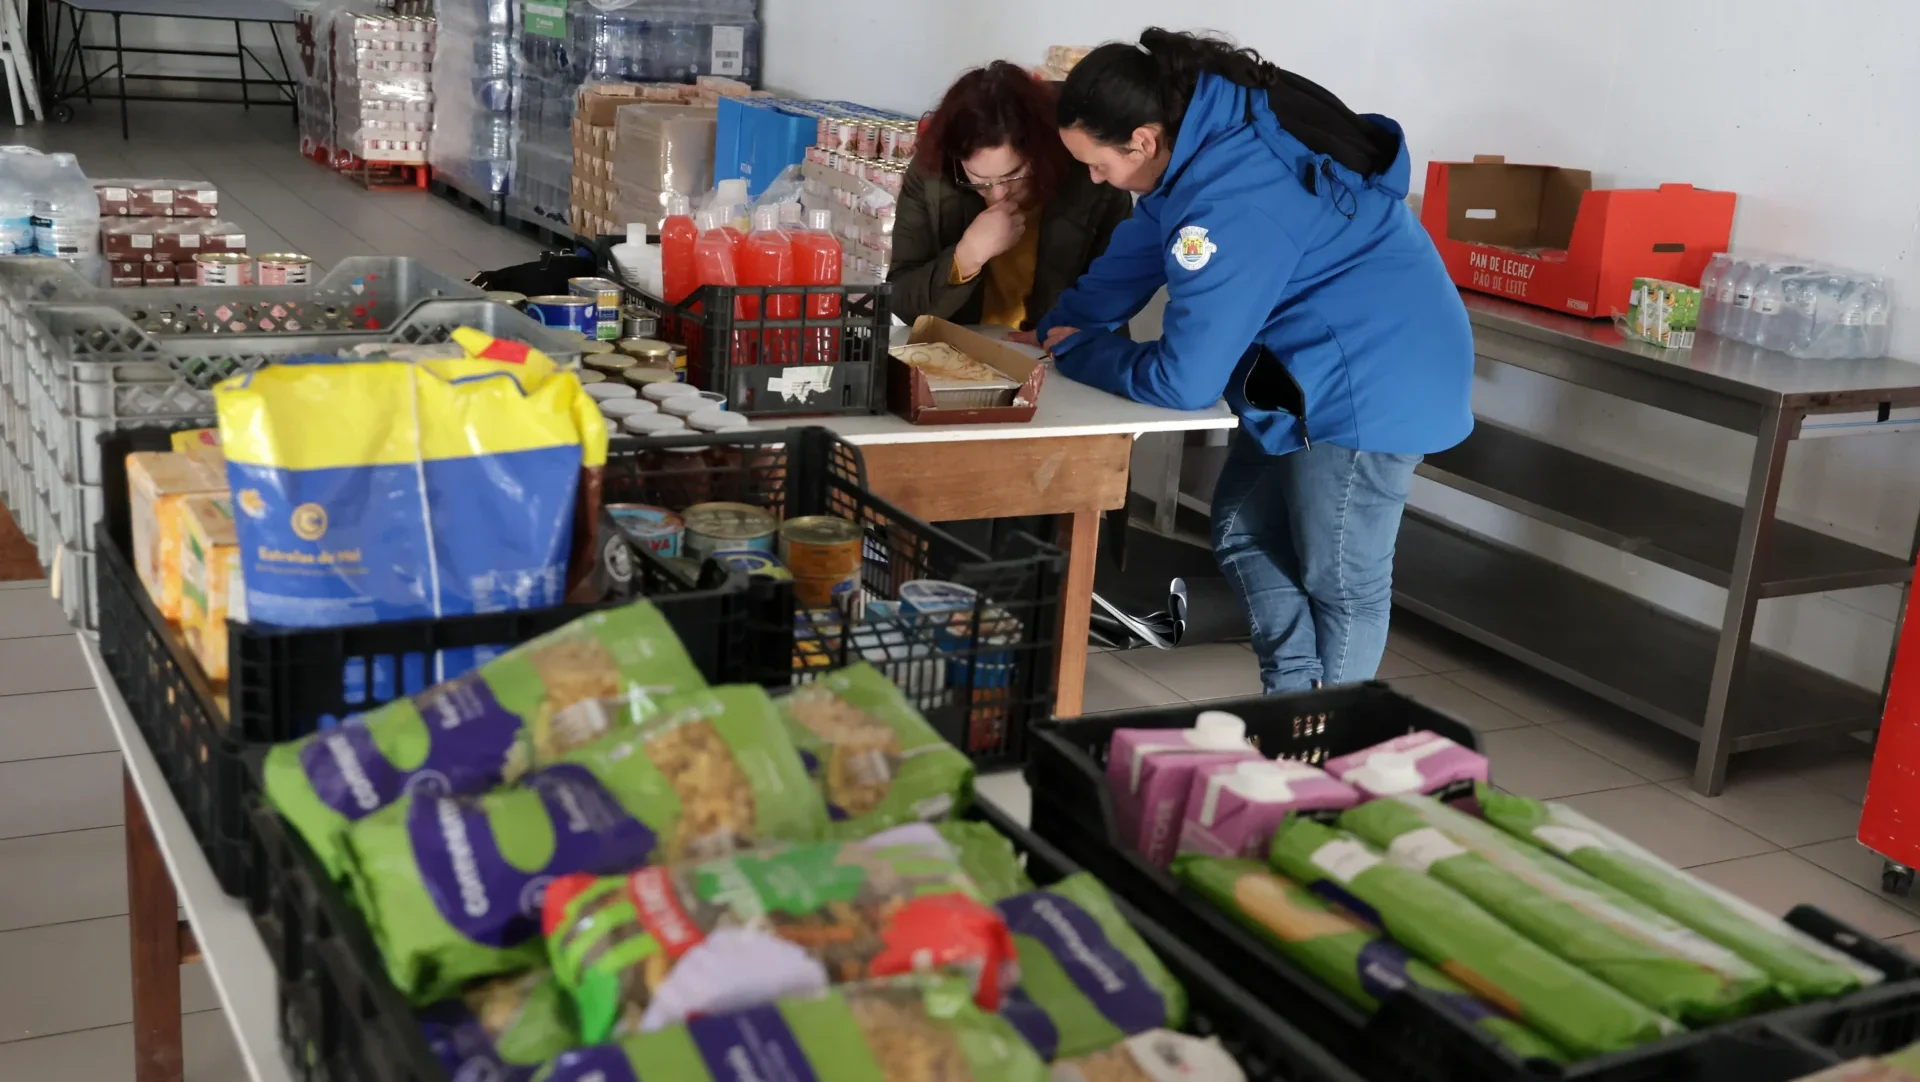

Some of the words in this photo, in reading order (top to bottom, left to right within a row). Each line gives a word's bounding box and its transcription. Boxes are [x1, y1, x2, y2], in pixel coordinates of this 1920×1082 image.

[1470, 251, 1487, 268] PAN
[1489, 256, 1501, 271] DE
[1503, 259, 1535, 279] LECHE/
[1473, 269, 1490, 286] PÃO
[1492, 276, 1503, 291] DE
[1505, 278, 1528, 297] LEITE
